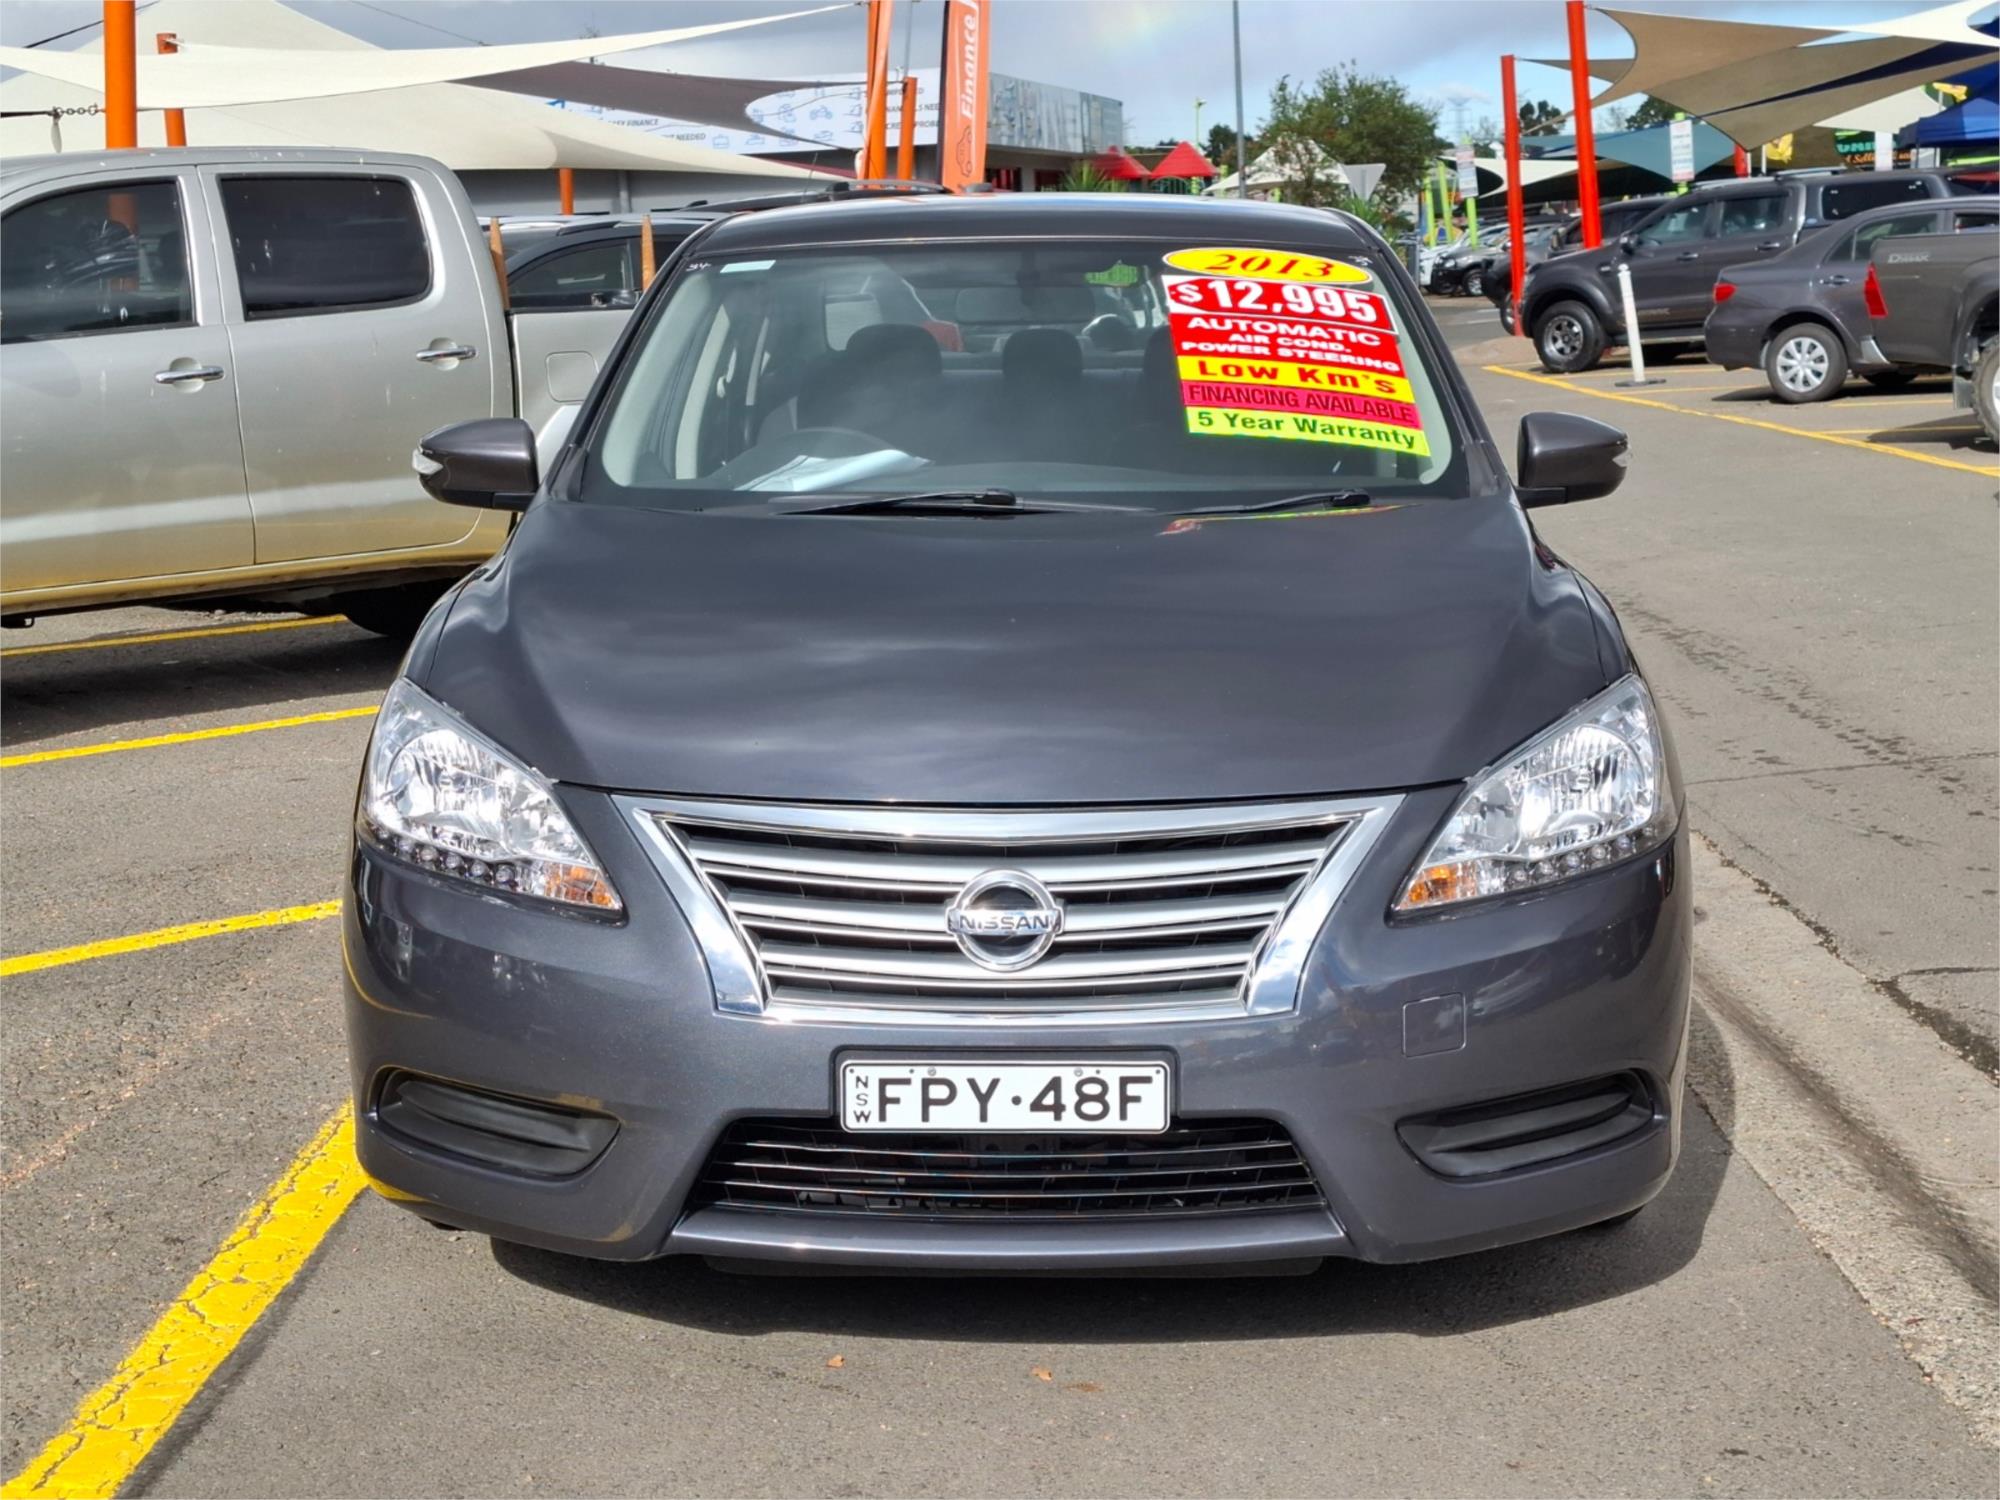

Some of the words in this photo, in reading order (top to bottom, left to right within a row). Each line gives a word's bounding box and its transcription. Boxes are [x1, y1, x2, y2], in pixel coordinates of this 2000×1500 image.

[960, 13, 977, 119] Finance
[676, 132, 706, 141] NEEDED
[1205, 253, 1335, 278] 2013
[1176, 279, 1378, 323] $12,995
[1187, 316, 1381, 346] AUTOMATIC
[1228, 333, 1270, 345] AIR
[1276, 336, 1352, 353] COND.
[1181, 341, 1271, 356] POWER
[1277, 347, 1400, 372] STEERING
[1188, 384, 1299, 409] FINANCING
[1305, 393, 1416, 424] AVAILABLE
[1198, 411, 1214, 427] 5
[1223, 412, 1285, 431] Year
[1293, 416, 1416, 450] Warranty
[959, 914, 1050, 930] NISSAN
